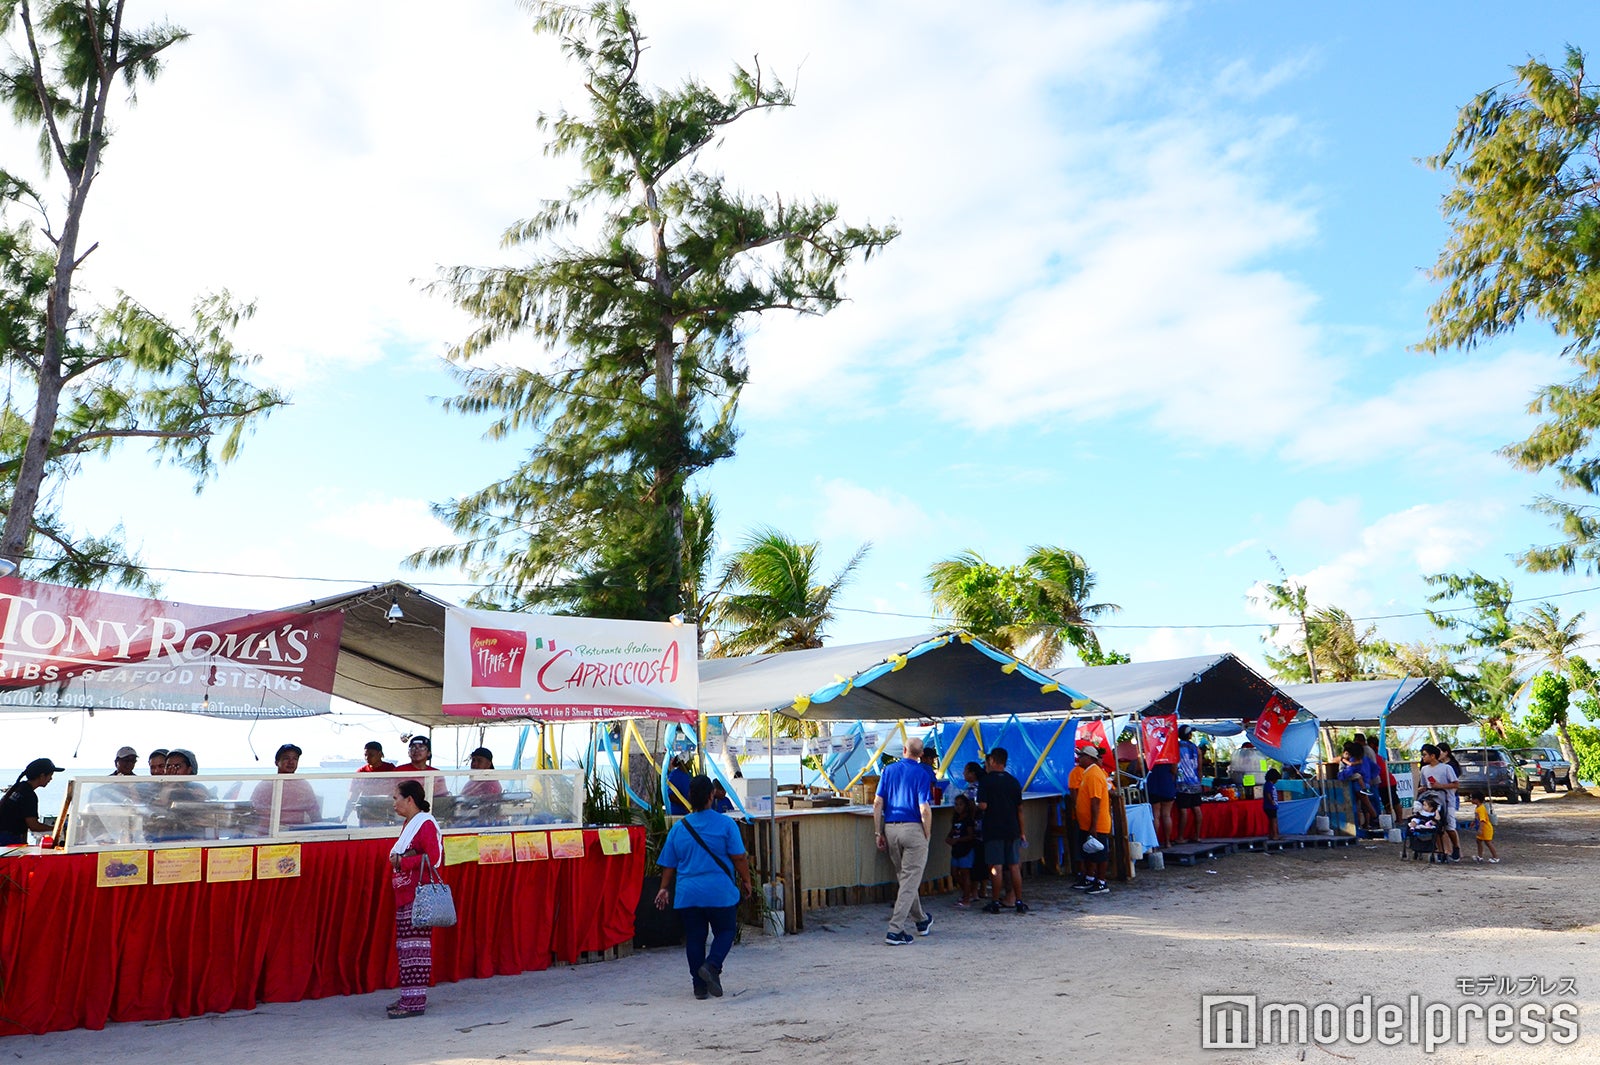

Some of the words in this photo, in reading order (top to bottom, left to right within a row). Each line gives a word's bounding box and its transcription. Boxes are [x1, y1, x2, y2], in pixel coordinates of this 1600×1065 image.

[0, 593, 147, 660] TONY
[144, 616, 309, 667] ROMA'S
[623, 642, 663, 655] Italiano
[537, 640, 679, 693] CAPRICCIOSA
[80, 669, 193, 685] SEAFOOD
[214, 671, 302, 691] STEAKS
[110, 696, 134, 709] Like
[138, 698, 146, 710] &
[550, 707, 563, 717] Like
